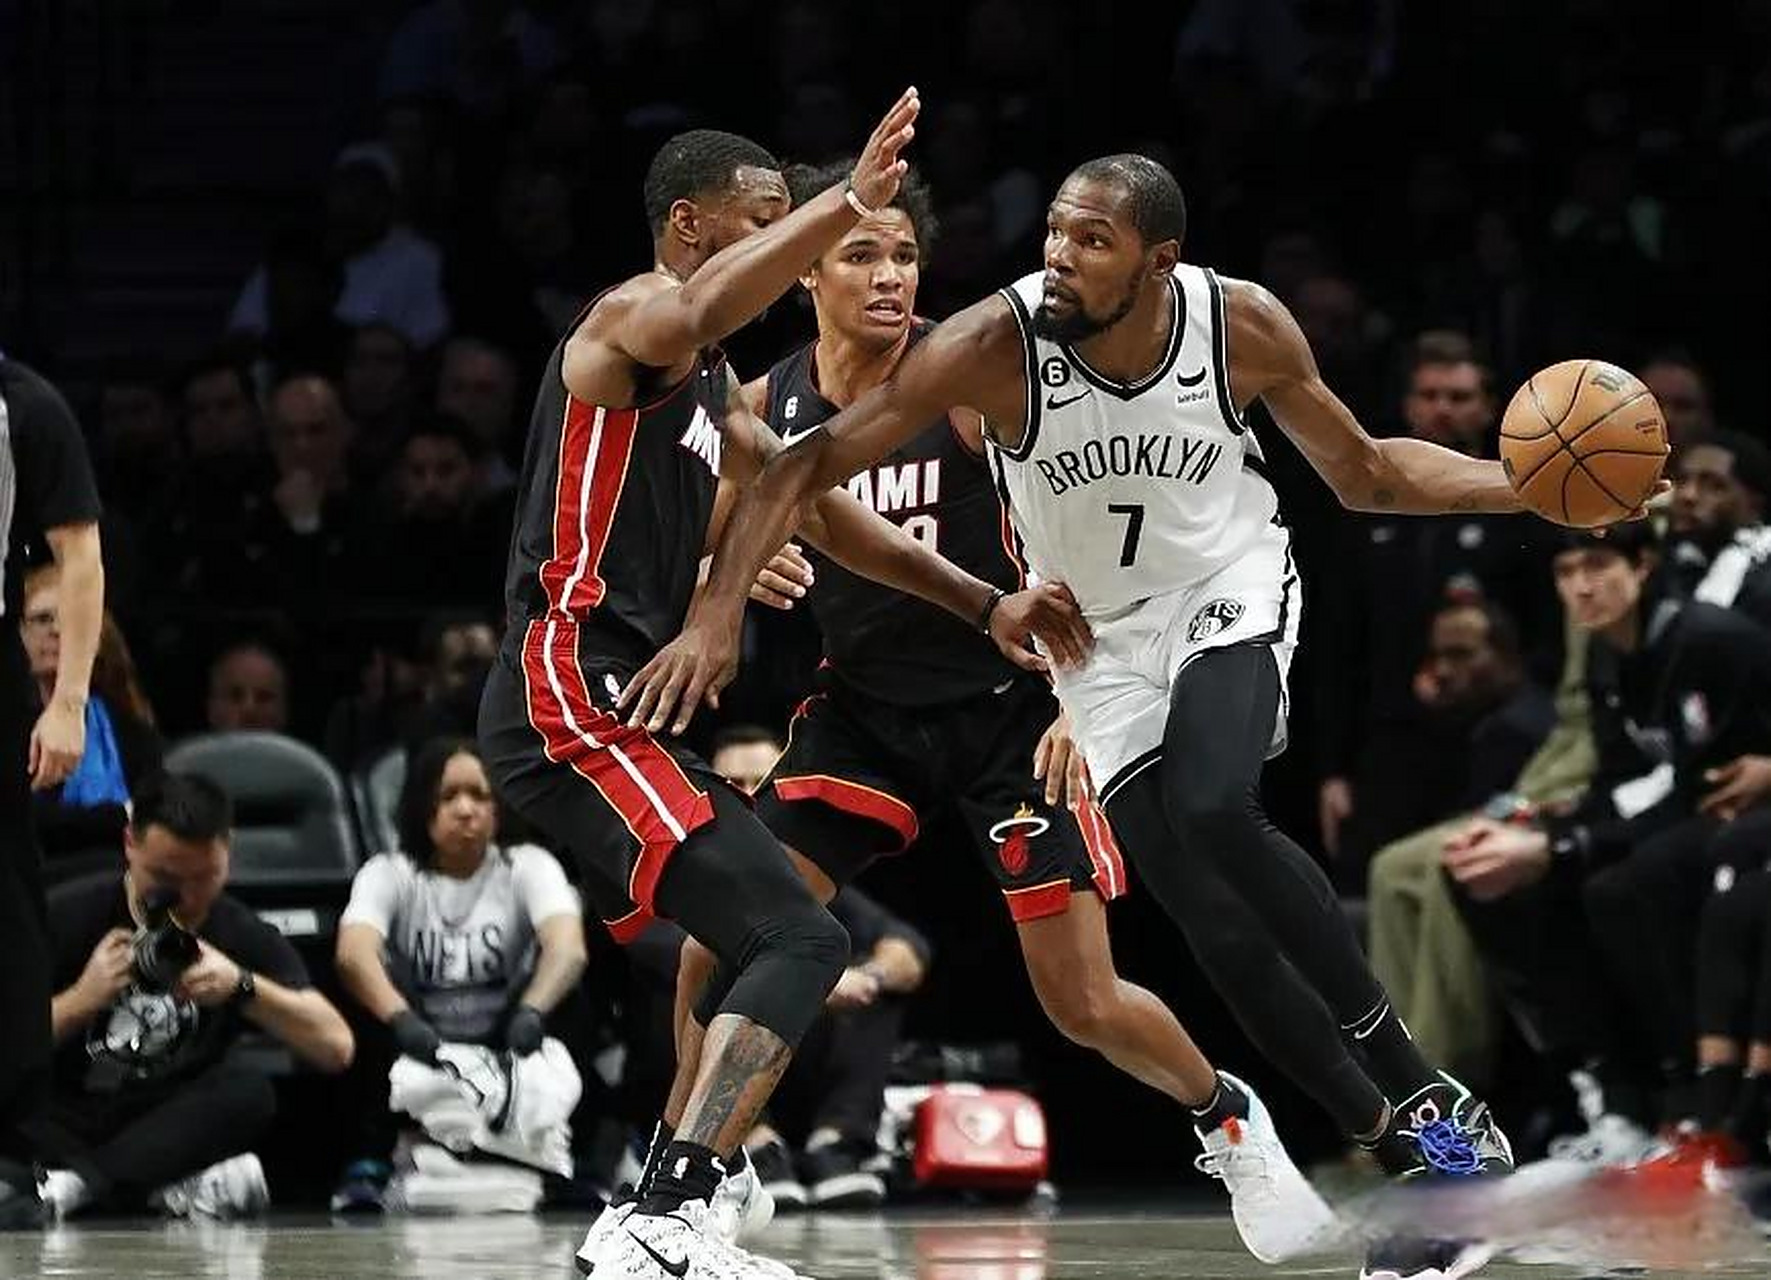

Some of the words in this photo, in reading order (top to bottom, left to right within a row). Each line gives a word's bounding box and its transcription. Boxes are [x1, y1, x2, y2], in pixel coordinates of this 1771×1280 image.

[1048, 361, 1064, 384] 6
[848, 459, 940, 512] AMI
[1036, 435, 1222, 495] BROOKLYN
[1108, 504, 1144, 567] 7
[411, 924, 504, 984] NETS
